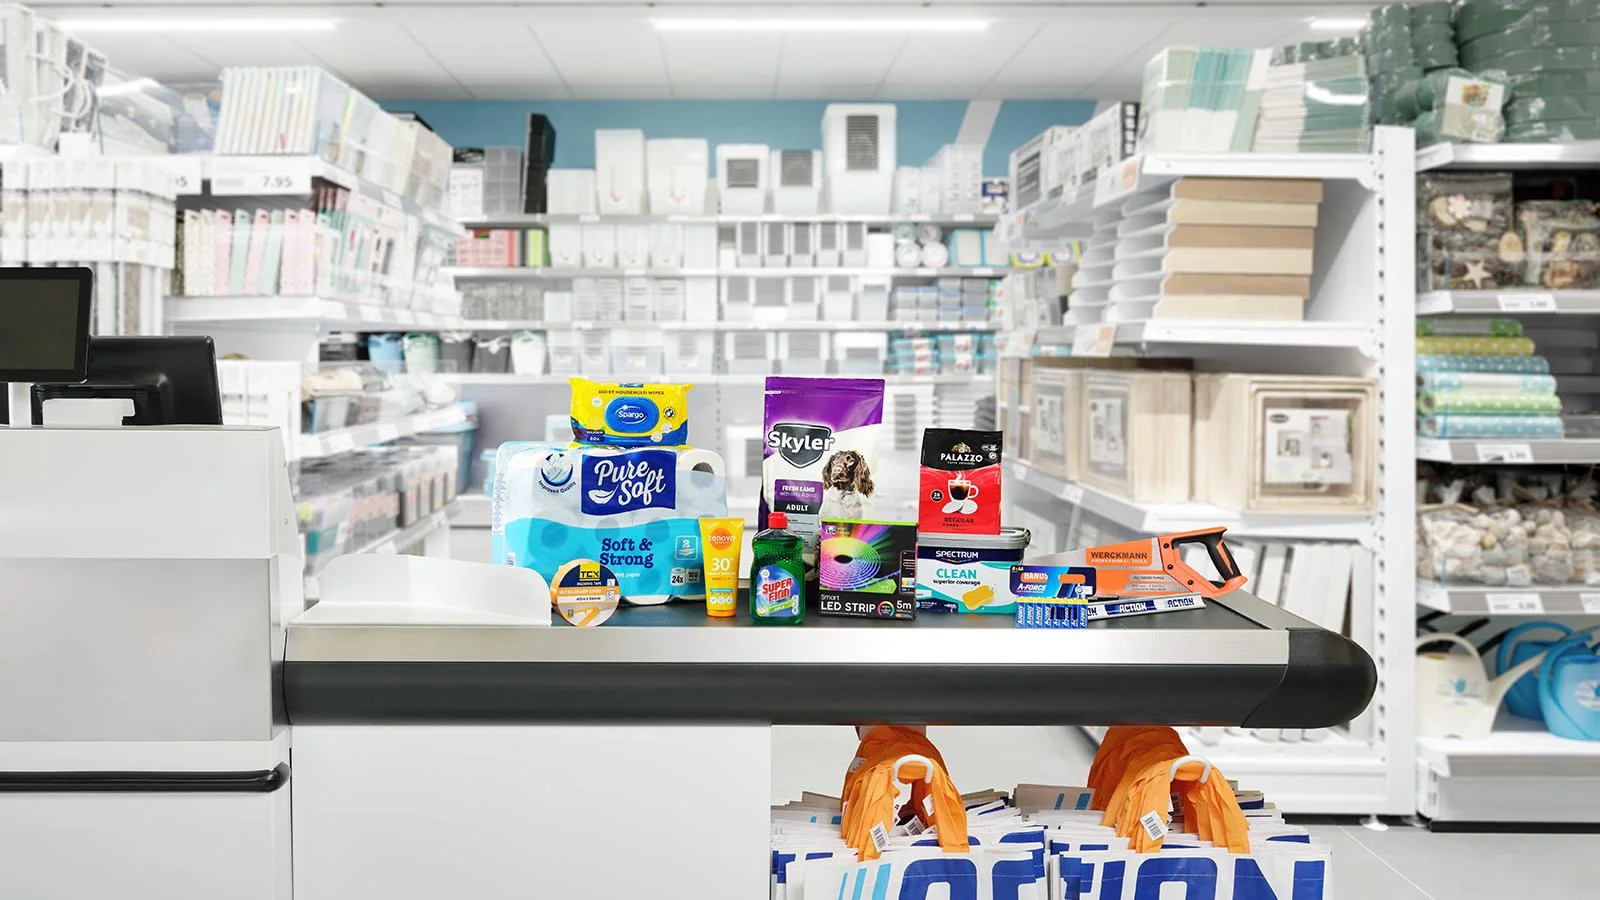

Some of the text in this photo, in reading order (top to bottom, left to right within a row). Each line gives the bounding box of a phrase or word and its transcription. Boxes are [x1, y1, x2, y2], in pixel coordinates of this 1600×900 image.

[261, 175, 293, 188] 7.95
[618, 410, 644, 419] Spargo
[768, 430, 835, 453] Skyler
[940, 453, 983, 462] PALAZZO
[594, 459, 651, 486] Pure
[617, 468, 667, 506] Soft
[785, 503, 809, 512] ADULT
[601, 537, 653, 551] Soft &
[599, 552, 654, 569] Strong
[935, 550, 979, 559] SPECTRUM
[1090, 551, 1148, 559] WERCKMANN
[711, 557, 731, 572] 30
[671, 575, 684, 584] 24x
[936, 568, 977, 579] CLEAN
[761, 577, 793, 595] SUPER
[932, 578, 956, 586] superior
[1016, 583, 1047, 592] A-FORCE
[820, 601, 842, 611] LED
[844, 602, 876, 613] STRIP
[896, 600, 912, 610] 5m
[1119, 601, 1147, 614] ACTION
[1167, 597, 1195, 609] ACTION
